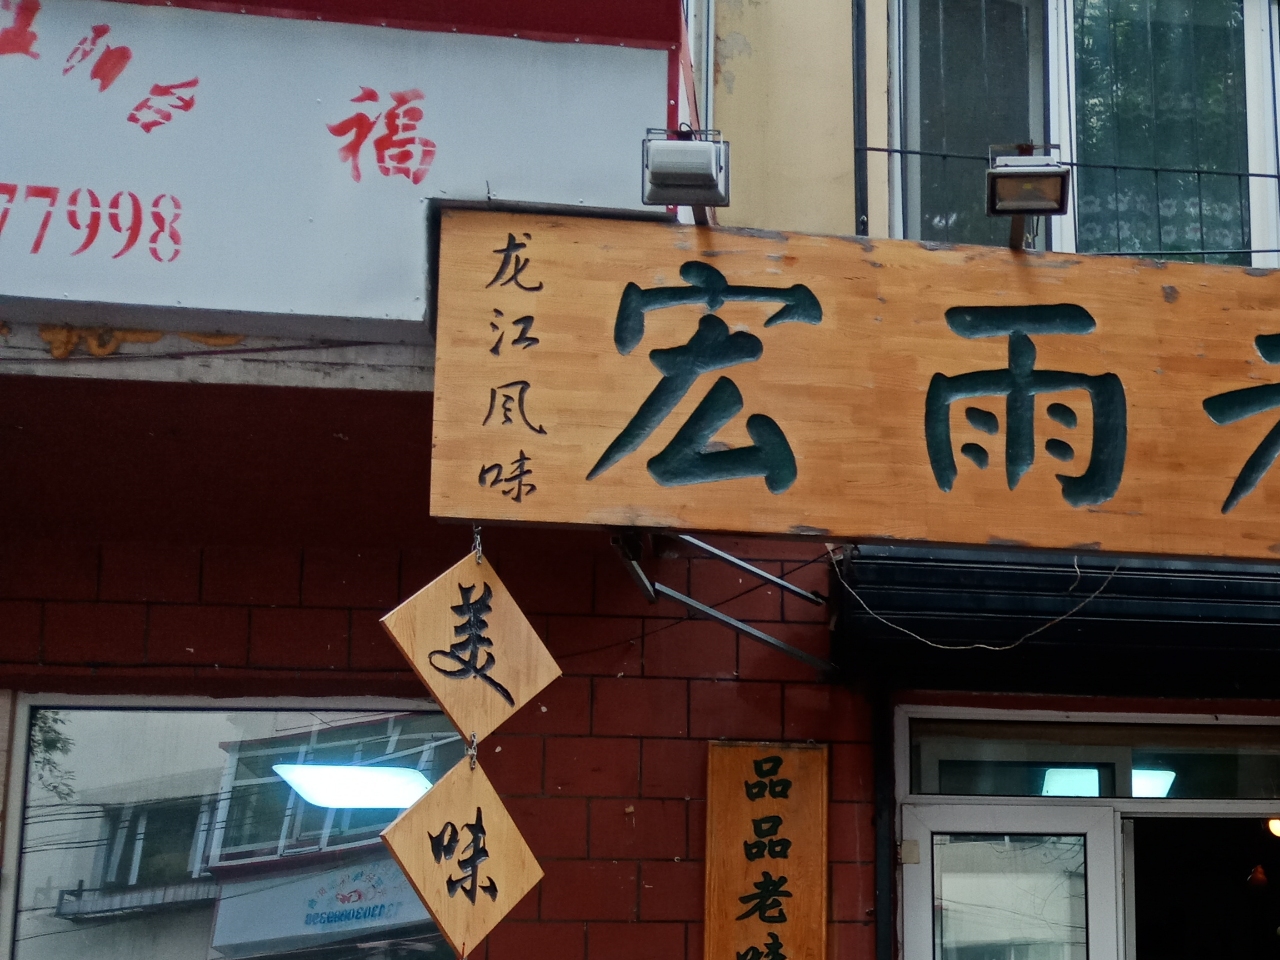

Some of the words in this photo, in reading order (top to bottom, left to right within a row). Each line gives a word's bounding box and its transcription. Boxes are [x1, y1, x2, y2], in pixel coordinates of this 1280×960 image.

[326, 86, 437, 185] 福
[478, 232, 546, 503] 龙江风味
